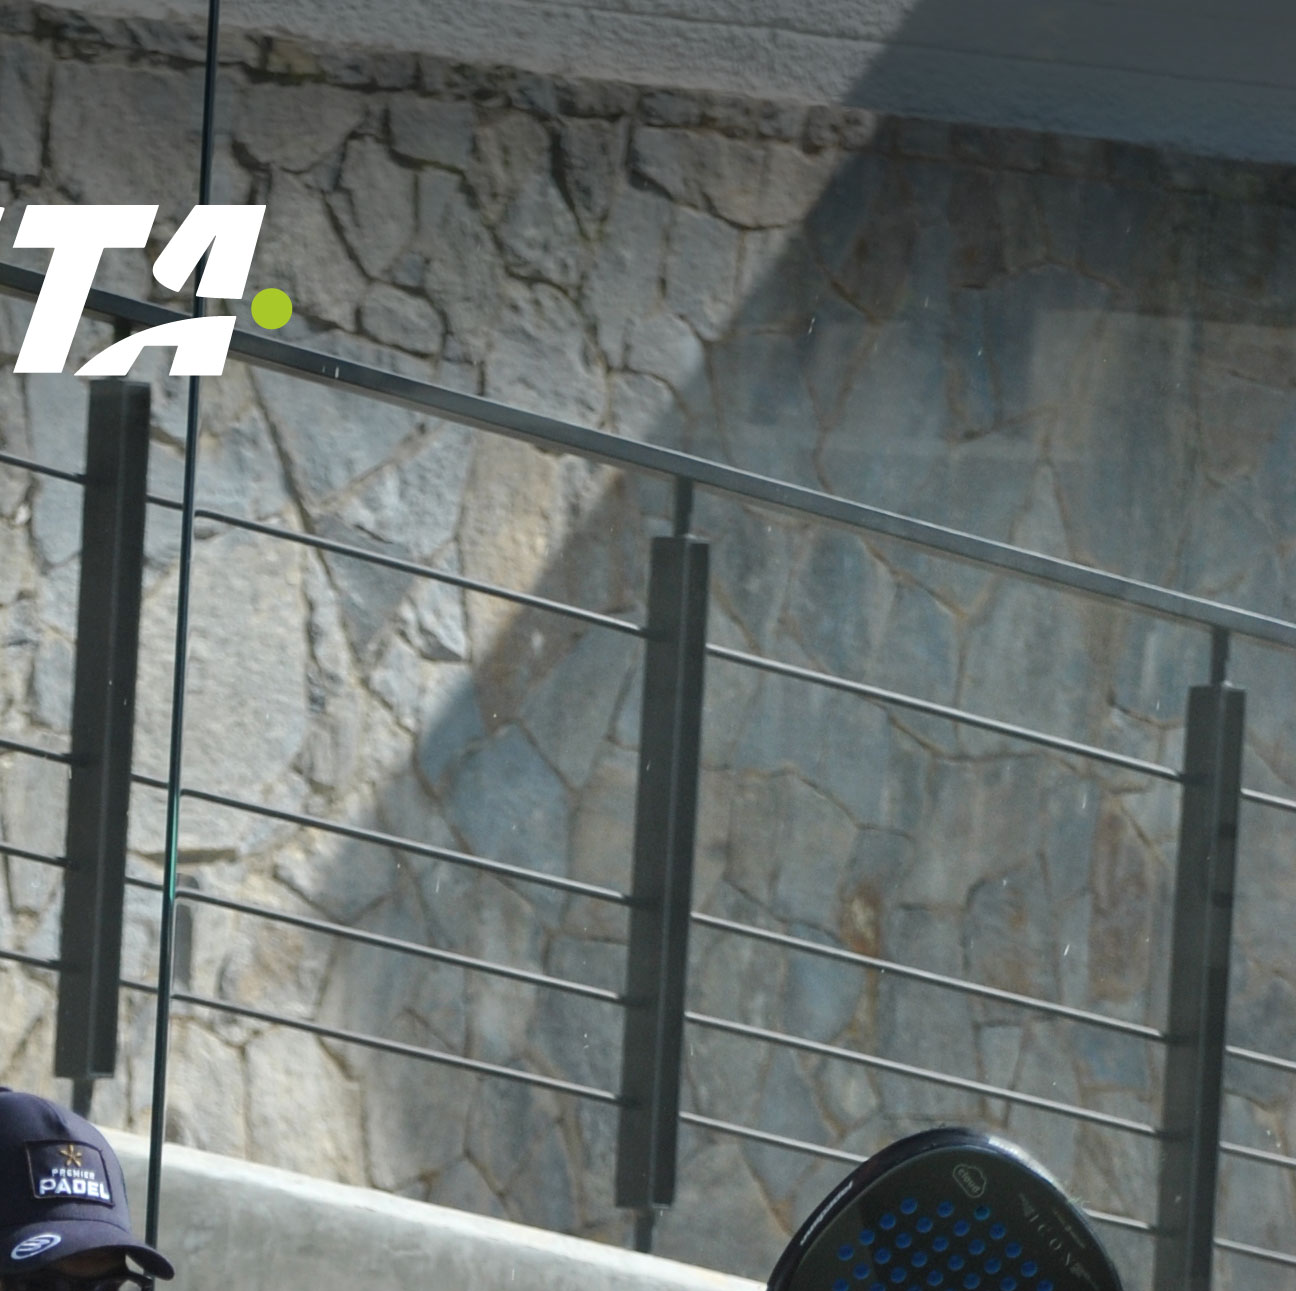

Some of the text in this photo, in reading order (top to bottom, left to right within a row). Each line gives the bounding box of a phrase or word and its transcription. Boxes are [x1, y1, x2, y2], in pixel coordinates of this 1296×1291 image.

[51, 1167, 96, 1180] PREMIER
[956, 1167, 982, 1194] cloud
[38, 1176, 111, 1200] PADEL
